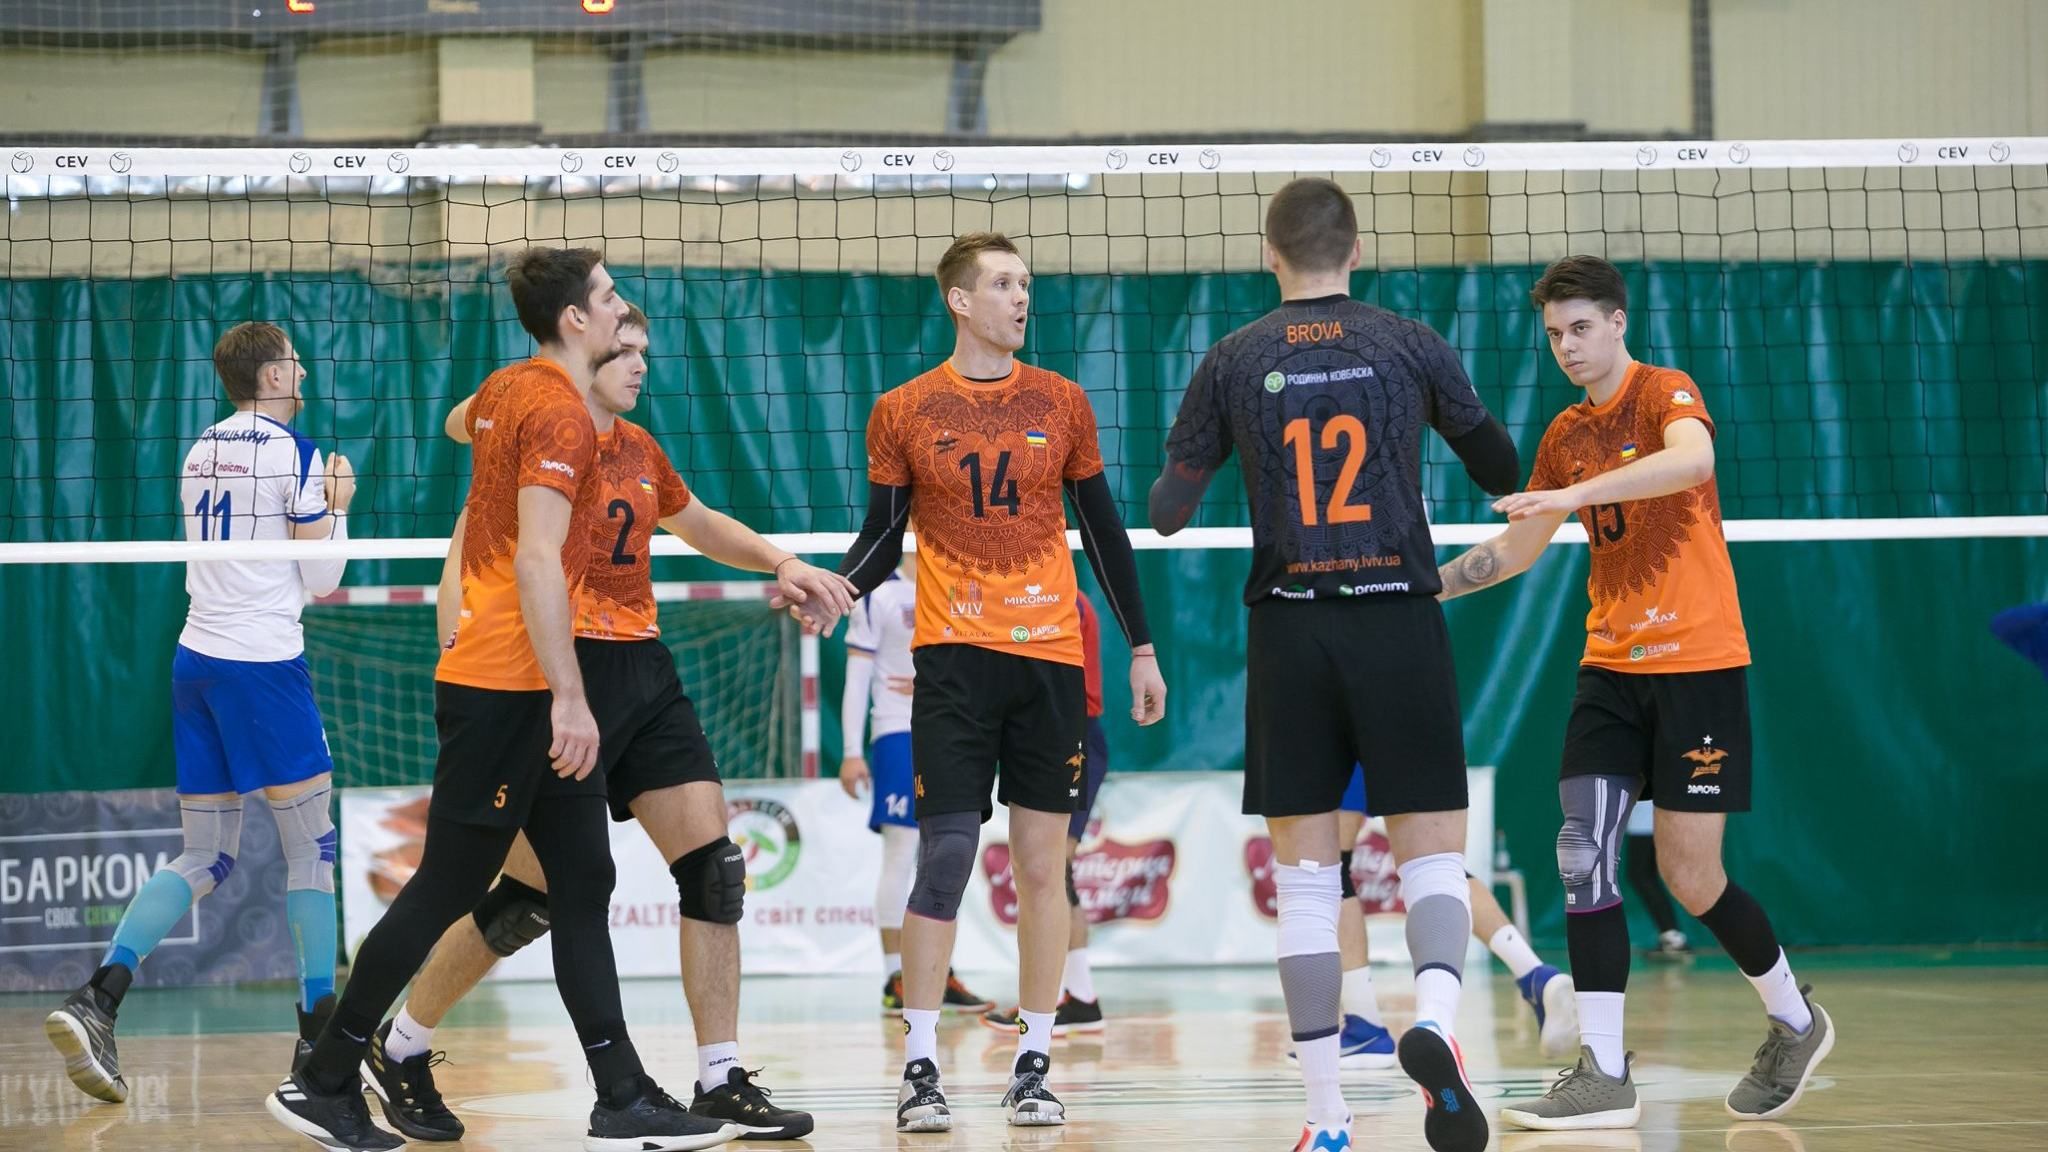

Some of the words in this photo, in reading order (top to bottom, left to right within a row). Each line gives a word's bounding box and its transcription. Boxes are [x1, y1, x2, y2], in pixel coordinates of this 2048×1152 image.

[1148, 152, 1180, 165] CEV
[1412, 150, 1444, 163] CEV
[1677, 149, 1708, 161] CEV
[1937, 147, 1968, 159] CEV
[56, 156, 89, 169] CEV
[334, 156, 367, 169] CEV
[604, 156, 637, 169] CEV
[883, 155, 916, 167] CEV
[1287, 321, 1344, 344] BROVA
[1283, 414, 1372, 526] 12
[959, 451, 1021, 518] 14
[195, 489, 232, 541] 11
[607, 498, 636, 565] 2
[1004, 594, 1061, 606] MIKOMAX
[950, 602, 983, 615] LVIV
[494, 784, 508, 808] 5
[885, 793, 909, 818] 14
[1, 851, 169, 904] БАРКОМ
